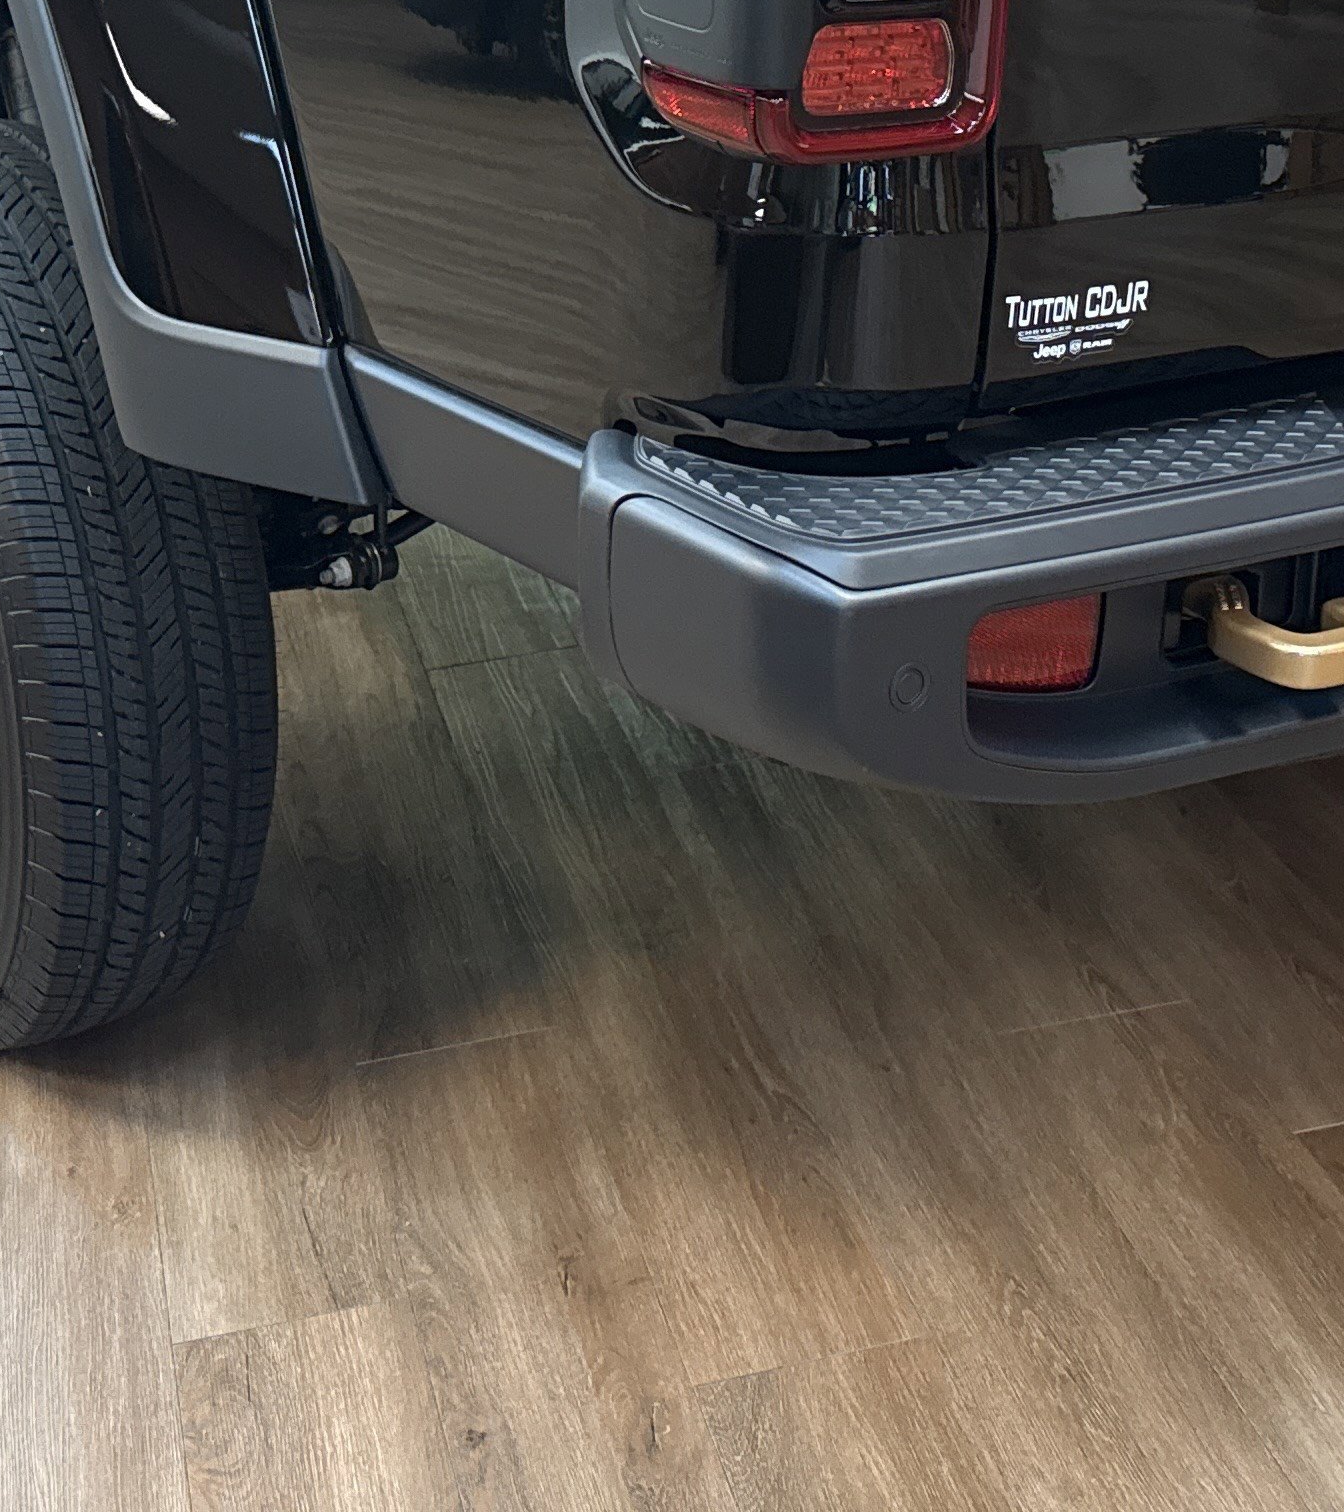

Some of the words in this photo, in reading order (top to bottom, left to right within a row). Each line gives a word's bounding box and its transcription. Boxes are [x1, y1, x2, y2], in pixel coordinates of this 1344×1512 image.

[1005, 293, 1080, 329] TUTTON
[1084, 279, 1150, 320] CDJR
[1033, 343, 1067, 360] Jeep
[1082, 338, 1114, 350] RAM
